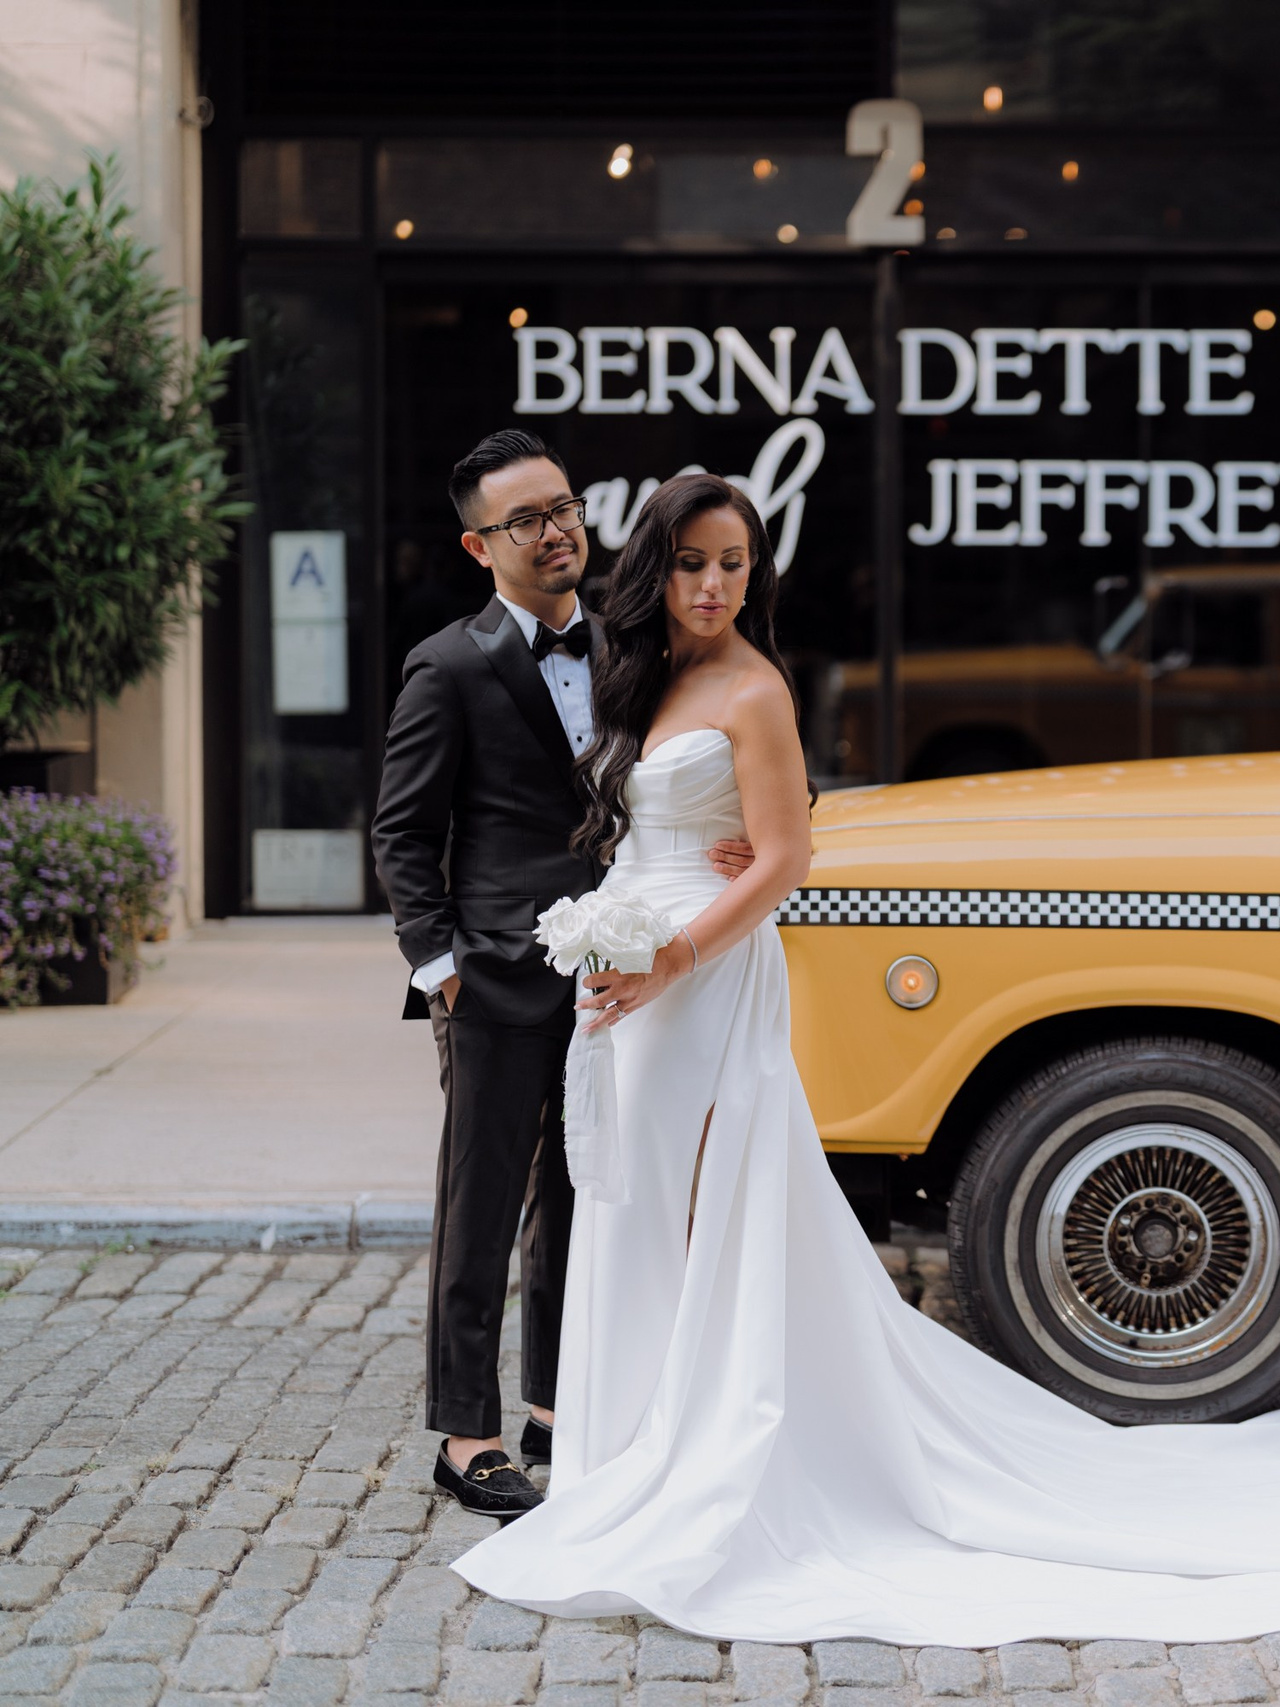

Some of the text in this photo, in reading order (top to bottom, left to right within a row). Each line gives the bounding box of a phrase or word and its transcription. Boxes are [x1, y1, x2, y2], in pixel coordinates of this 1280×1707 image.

[846, 98, 925, 246] 2
[512, 327, 1255, 415] BERNA DETTE
[583, 417, 826, 577] ad
[289, 548, 325, 588] A
